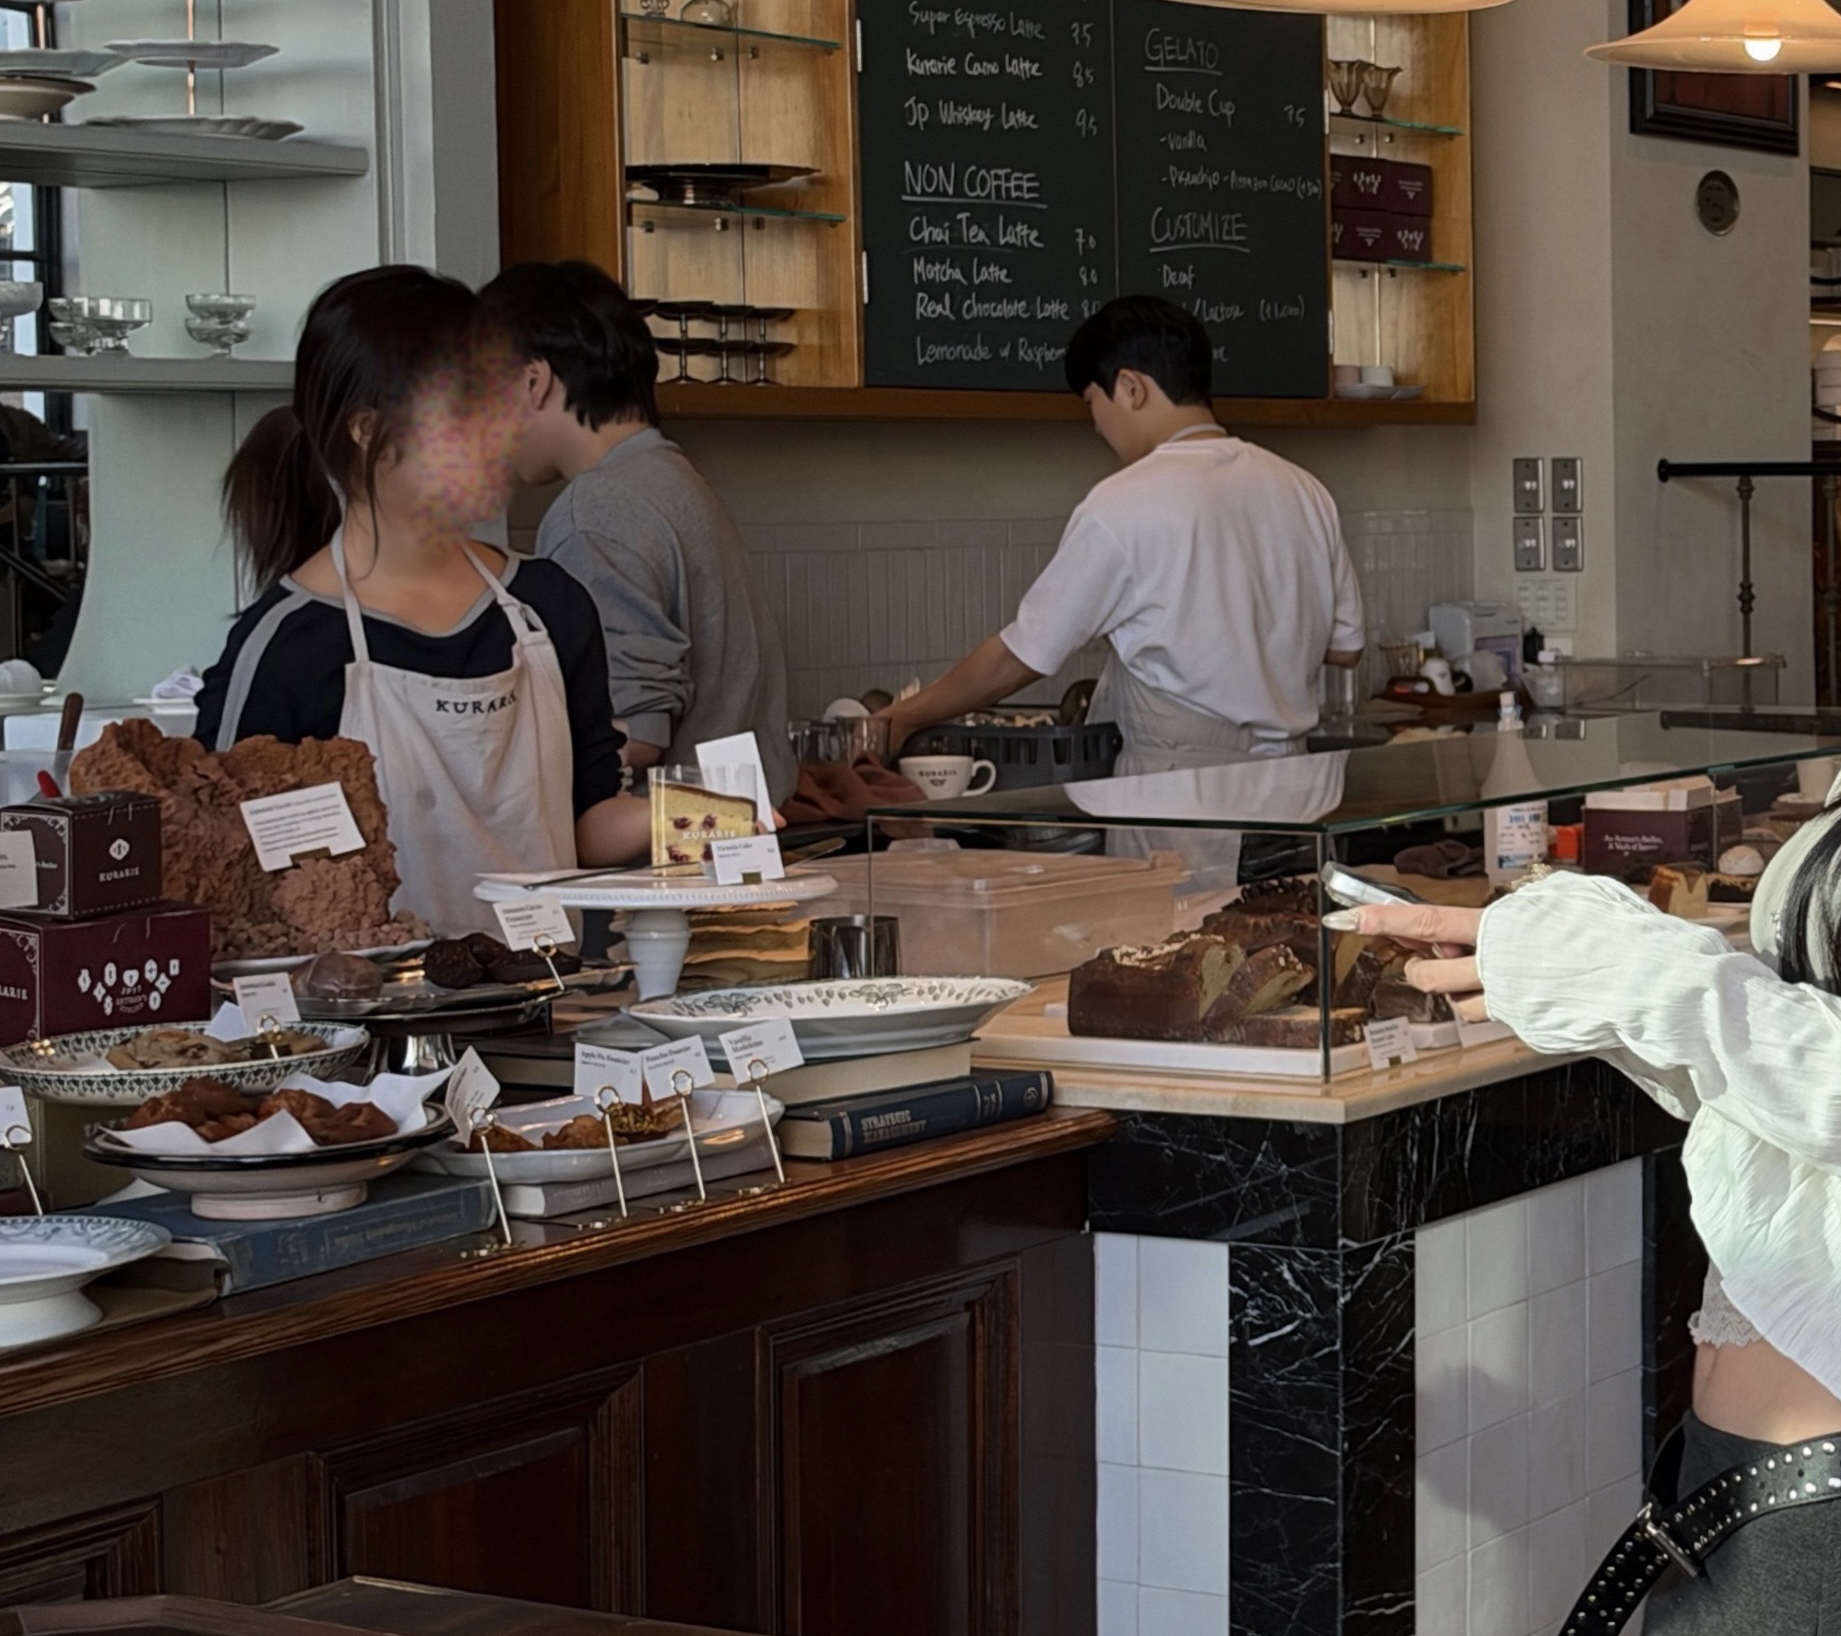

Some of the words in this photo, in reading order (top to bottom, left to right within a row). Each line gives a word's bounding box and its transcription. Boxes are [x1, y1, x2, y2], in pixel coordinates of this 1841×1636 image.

[909, 1, 950, 35] Super
[1009, 12, 1046, 40] Latte
[1145, 28, 1219, 69] GELATO
[1005, 54, 1043, 81] Latte
[938, 99, 995, 131] Whiskey
[1001, 102, 1039, 130] Latte
[1156, 83, 1204, 114] Double
[1208, 89, 1236, 128] Cup
[905, 160, 955, 196] NON
[963, 165, 1040, 201] COFFEE
[909, 216, 950, 246] Chai
[956, 212, 991, 246] Tea
[999, 214, 1045, 248] Latte
[1151, 206, 1248, 243] CUSTOMIZE
[913, 256, 968, 285] Matcha
[973, 256, 1013, 285] Latte
[916, 292, 956, 320] Real
[1036, 296, 1070, 321] Latte
[916, 332, 992, 366] Lemonade
[99, 867, 140, 882] KURARIE
